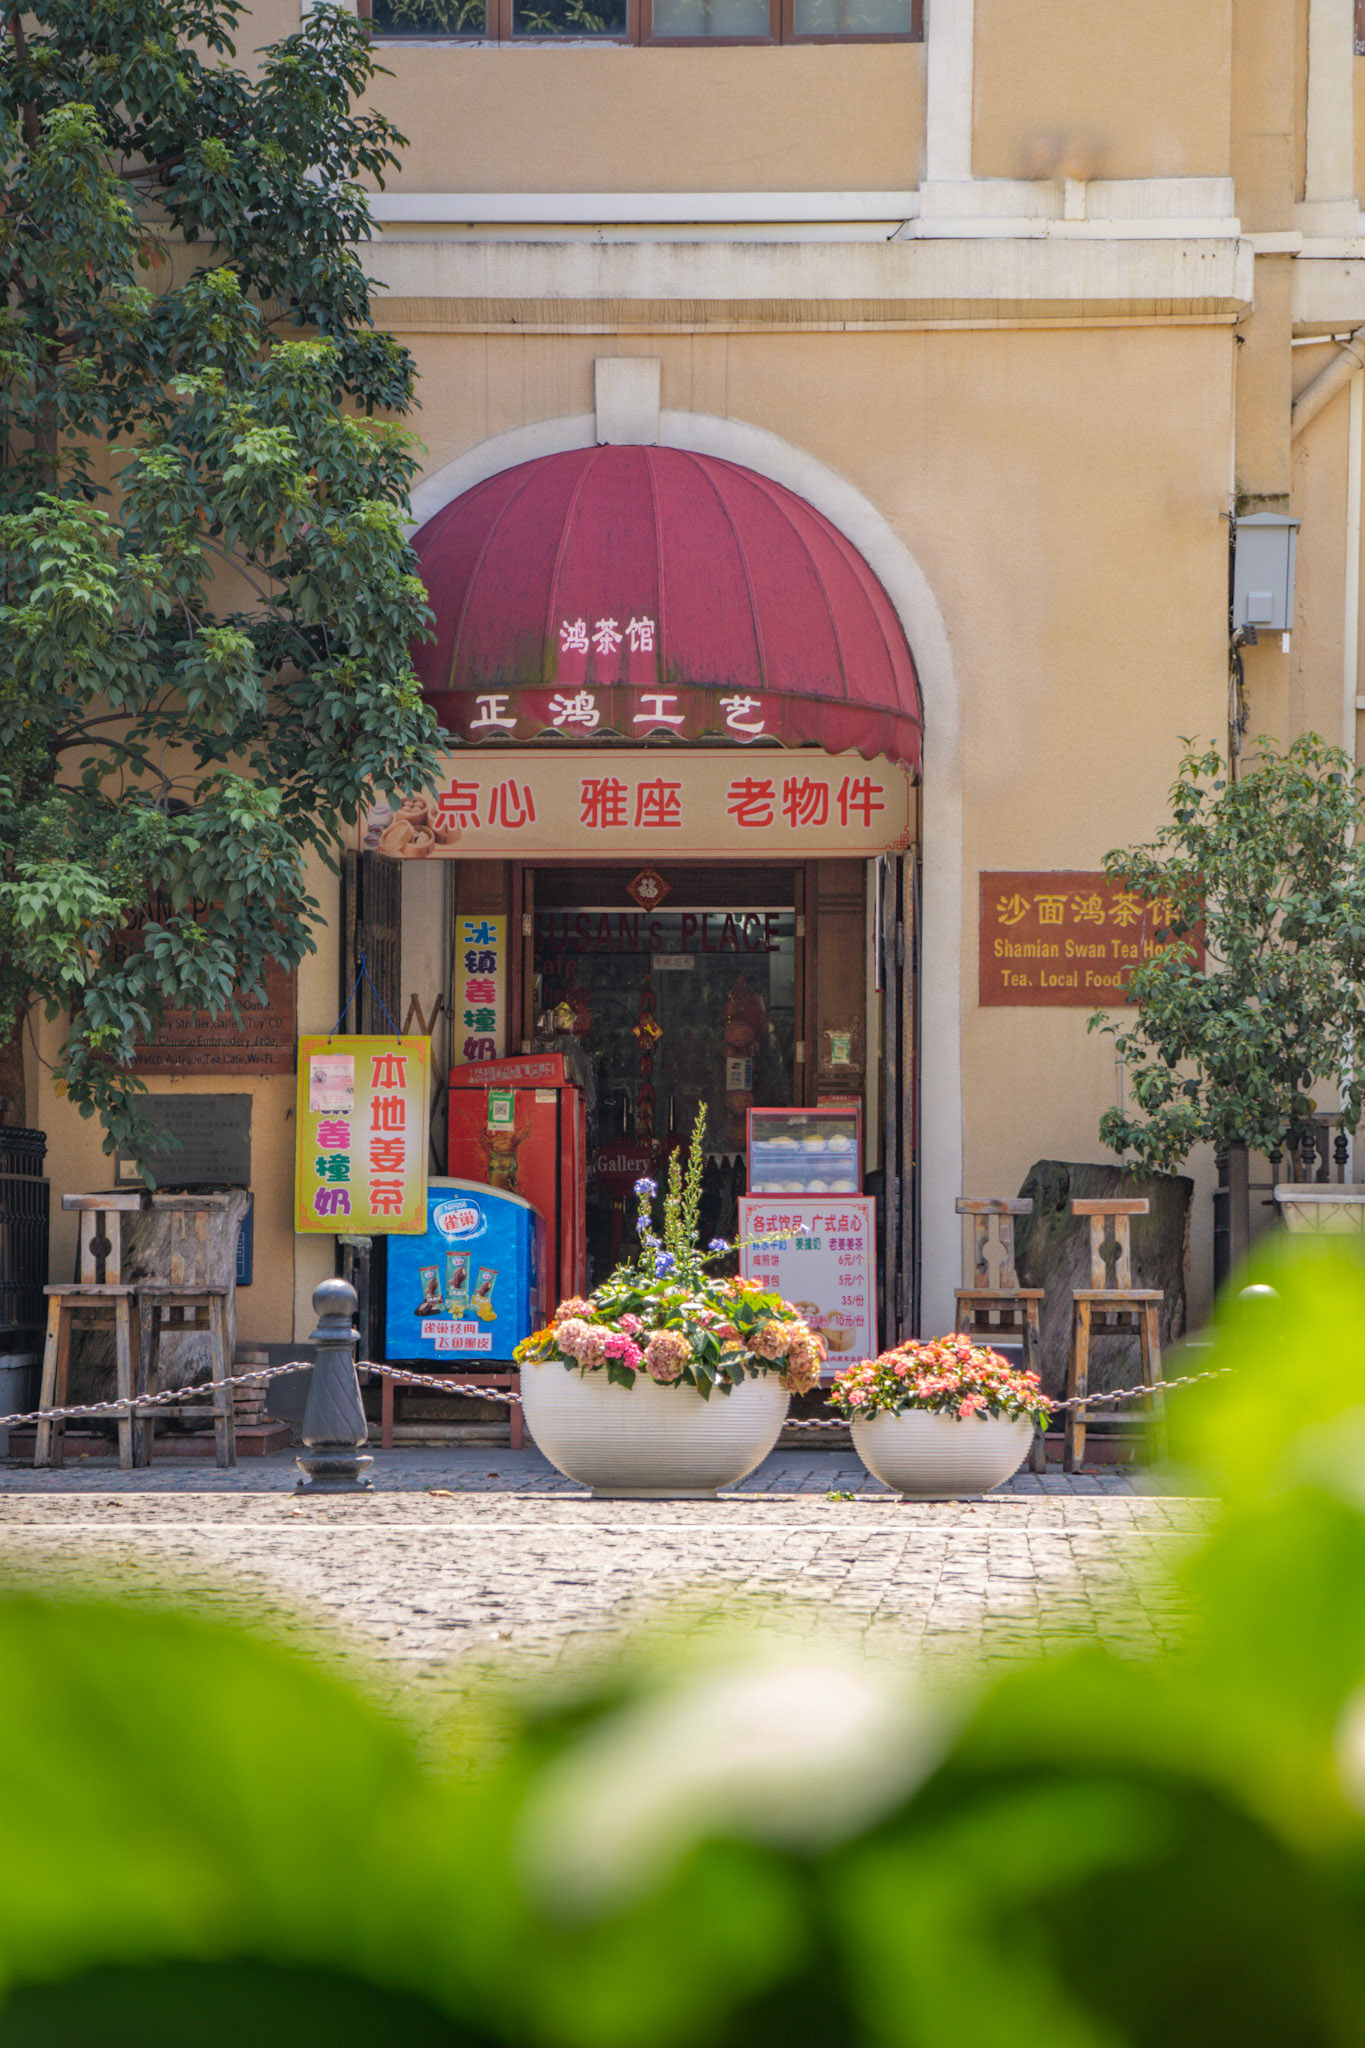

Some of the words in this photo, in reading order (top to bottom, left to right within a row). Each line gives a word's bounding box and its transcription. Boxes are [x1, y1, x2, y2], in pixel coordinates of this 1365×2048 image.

[559, 616, 655, 655] 鸿茶馆
[434, 779, 536, 829] 点心
[579, 776, 683, 829] 雅座
[726, 776, 886, 828] 老物件
[681, 912, 780, 951] PLACE
[994, 938, 1059, 958] Shamian
[1065, 939, 1106, 958] Swan
[1111, 939, 1138, 958] Tea
[1041, 970, 1078, 987] Local
[1086, 970, 1121, 987] Food
[598, 1155, 650, 1174] Gallery
[444, 1211, 474, 1231] 雀巢
[753, 1214, 803, 1233] 各式饮品
[812, 1214, 863, 1233] 广式点心
[838, 1254, 864, 1267] 6元/个
[838, 1274, 864, 1287] 5元/个
[841, 1294, 865, 1307] 35/份
[423, 1322, 476, 1335] 雀巢经典
[438, 1336, 490, 1349] 飞鱼脆皮
